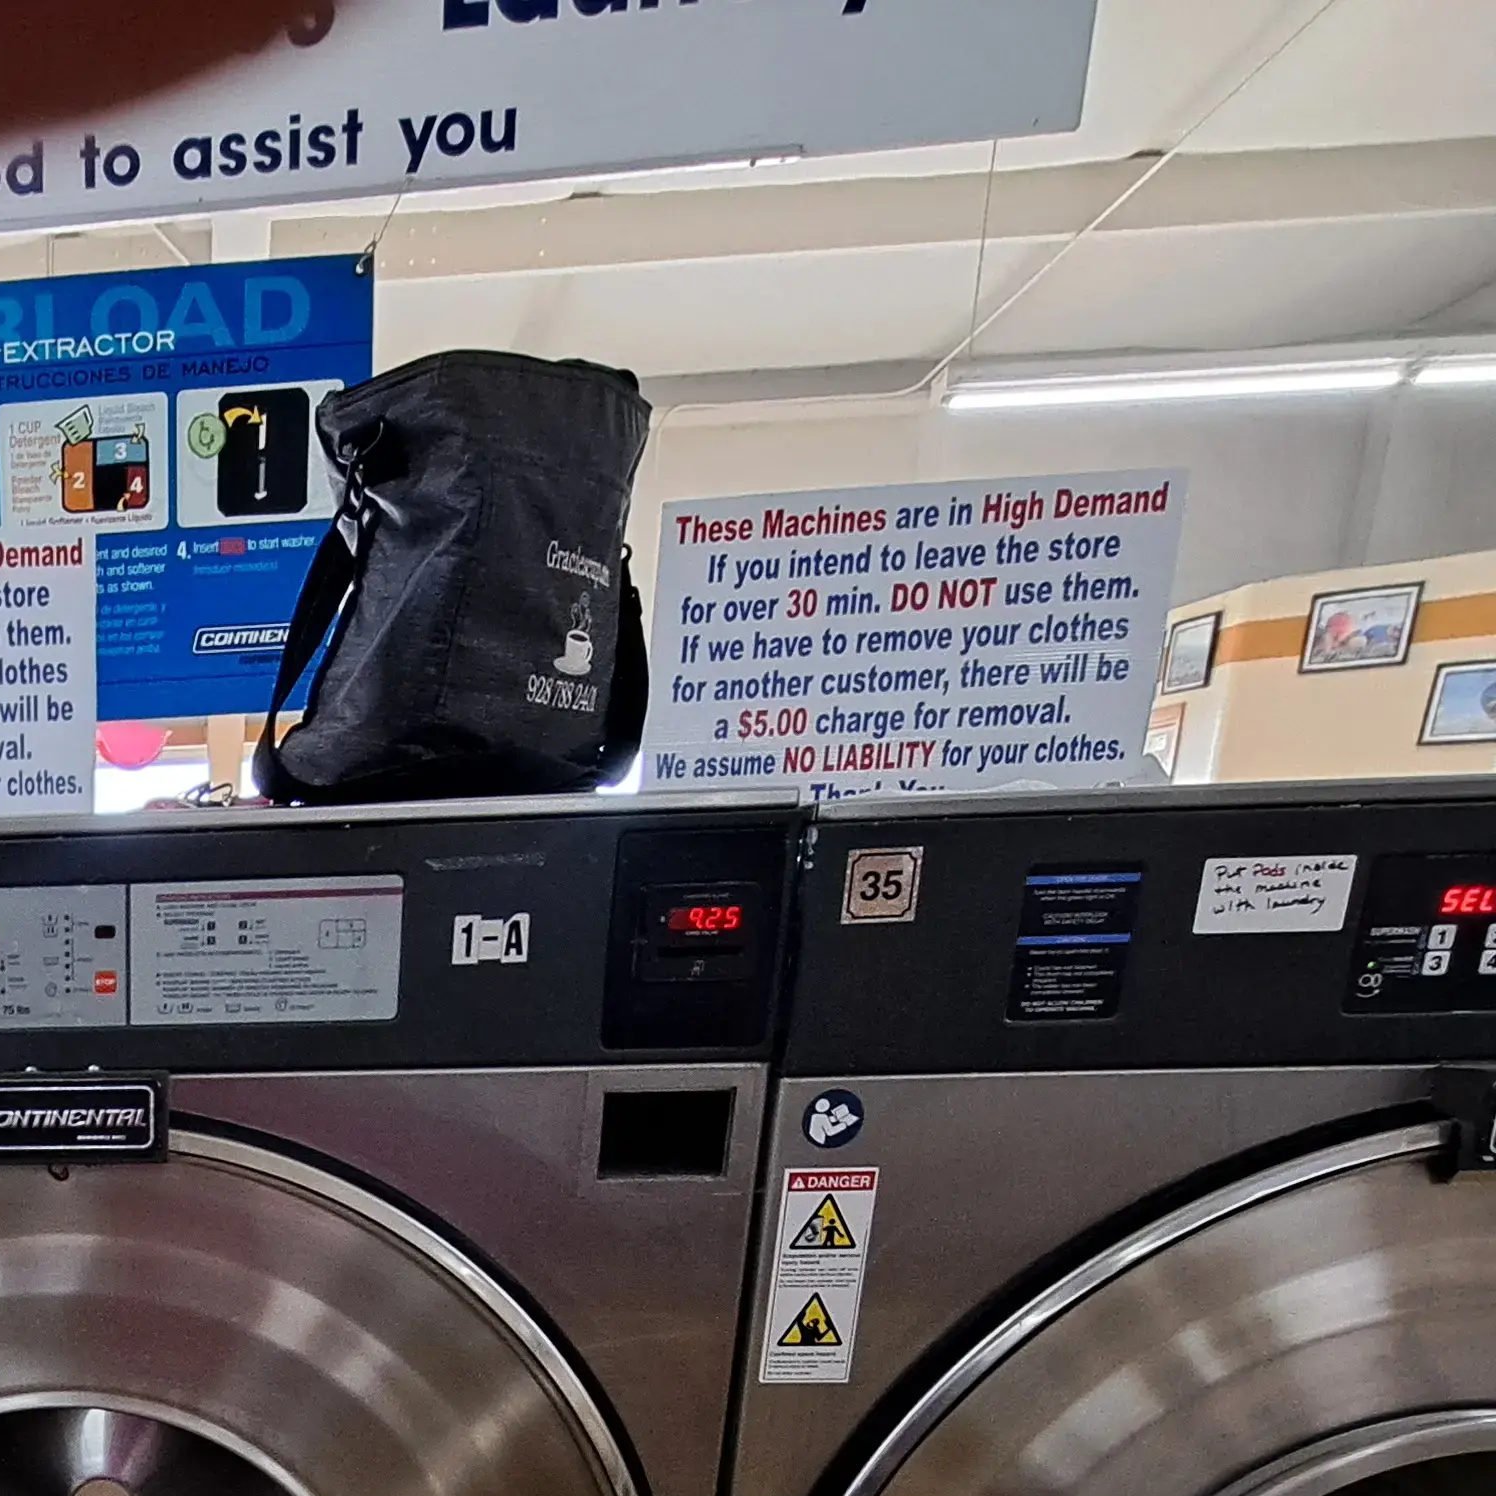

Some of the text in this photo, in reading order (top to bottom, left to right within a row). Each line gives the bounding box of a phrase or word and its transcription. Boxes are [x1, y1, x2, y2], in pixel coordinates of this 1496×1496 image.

[81, 135, 140, 190] to
[173, 108, 363, 182] assist
[398, 103, 519, 176] you
[143, 363, 171, 380] DE
[183, 356, 270, 375] MANEJO
[115, 442, 127, 460] 3
[73, 472, 85, 489] 2
[130, 476, 143, 493] 4
[675, 482, 1169, 545] These Machines are in High Demand
[177, 541, 191, 560] 4.
[6, 618, 71, 647] them.
[200, 630, 288, 648] CONTINEN
[47, 694, 73, 722] be
[7, 769, 82, 796] clothes.
[1215, 865, 1247, 880] Put
[1253, 863, 1286, 878] Pods
[860, 870, 903, 901] 35
[1214, 878, 1322, 895] the machine
[1267, 896, 1326, 915] laundry
[460, 920, 524, 958] 1-A
[1438, 930, 1447, 945] 1
[1429, 955, 1443, 971] 3
[808, 1175, 871, 1188] DANGER
